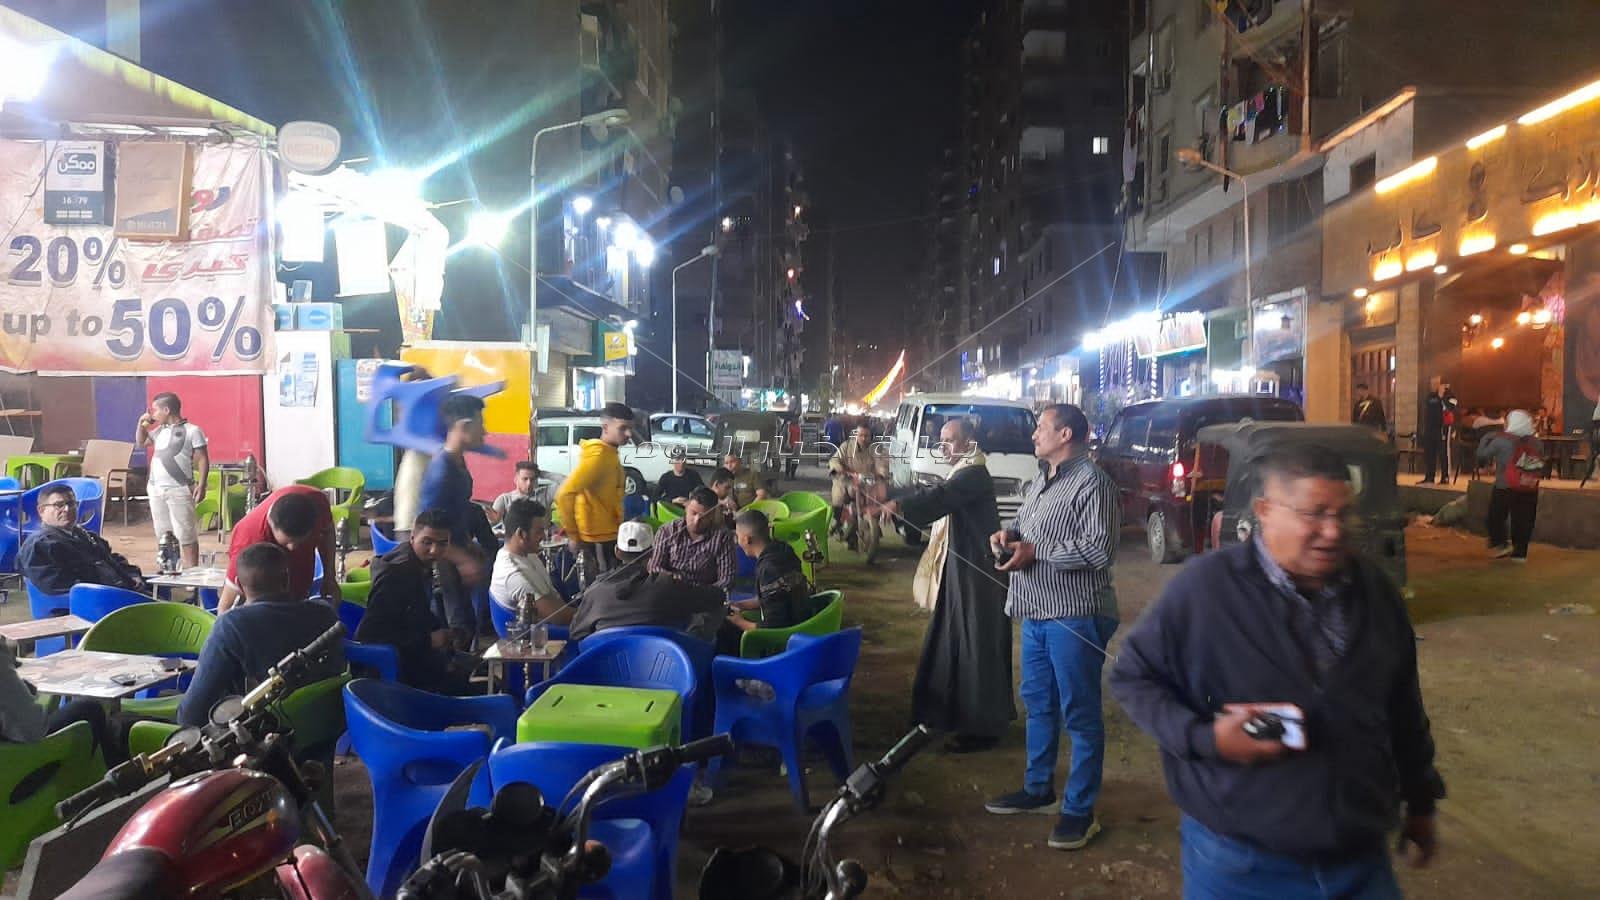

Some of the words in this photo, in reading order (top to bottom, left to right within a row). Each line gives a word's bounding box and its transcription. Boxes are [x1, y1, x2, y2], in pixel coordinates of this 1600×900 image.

[58, 154, 96, 173] ممكن
[8, 235, 127, 289] 20%
[2, 312, 52, 341] up
[66, 308, 103, 337] to
[105, 296, 264, 362] 50%
